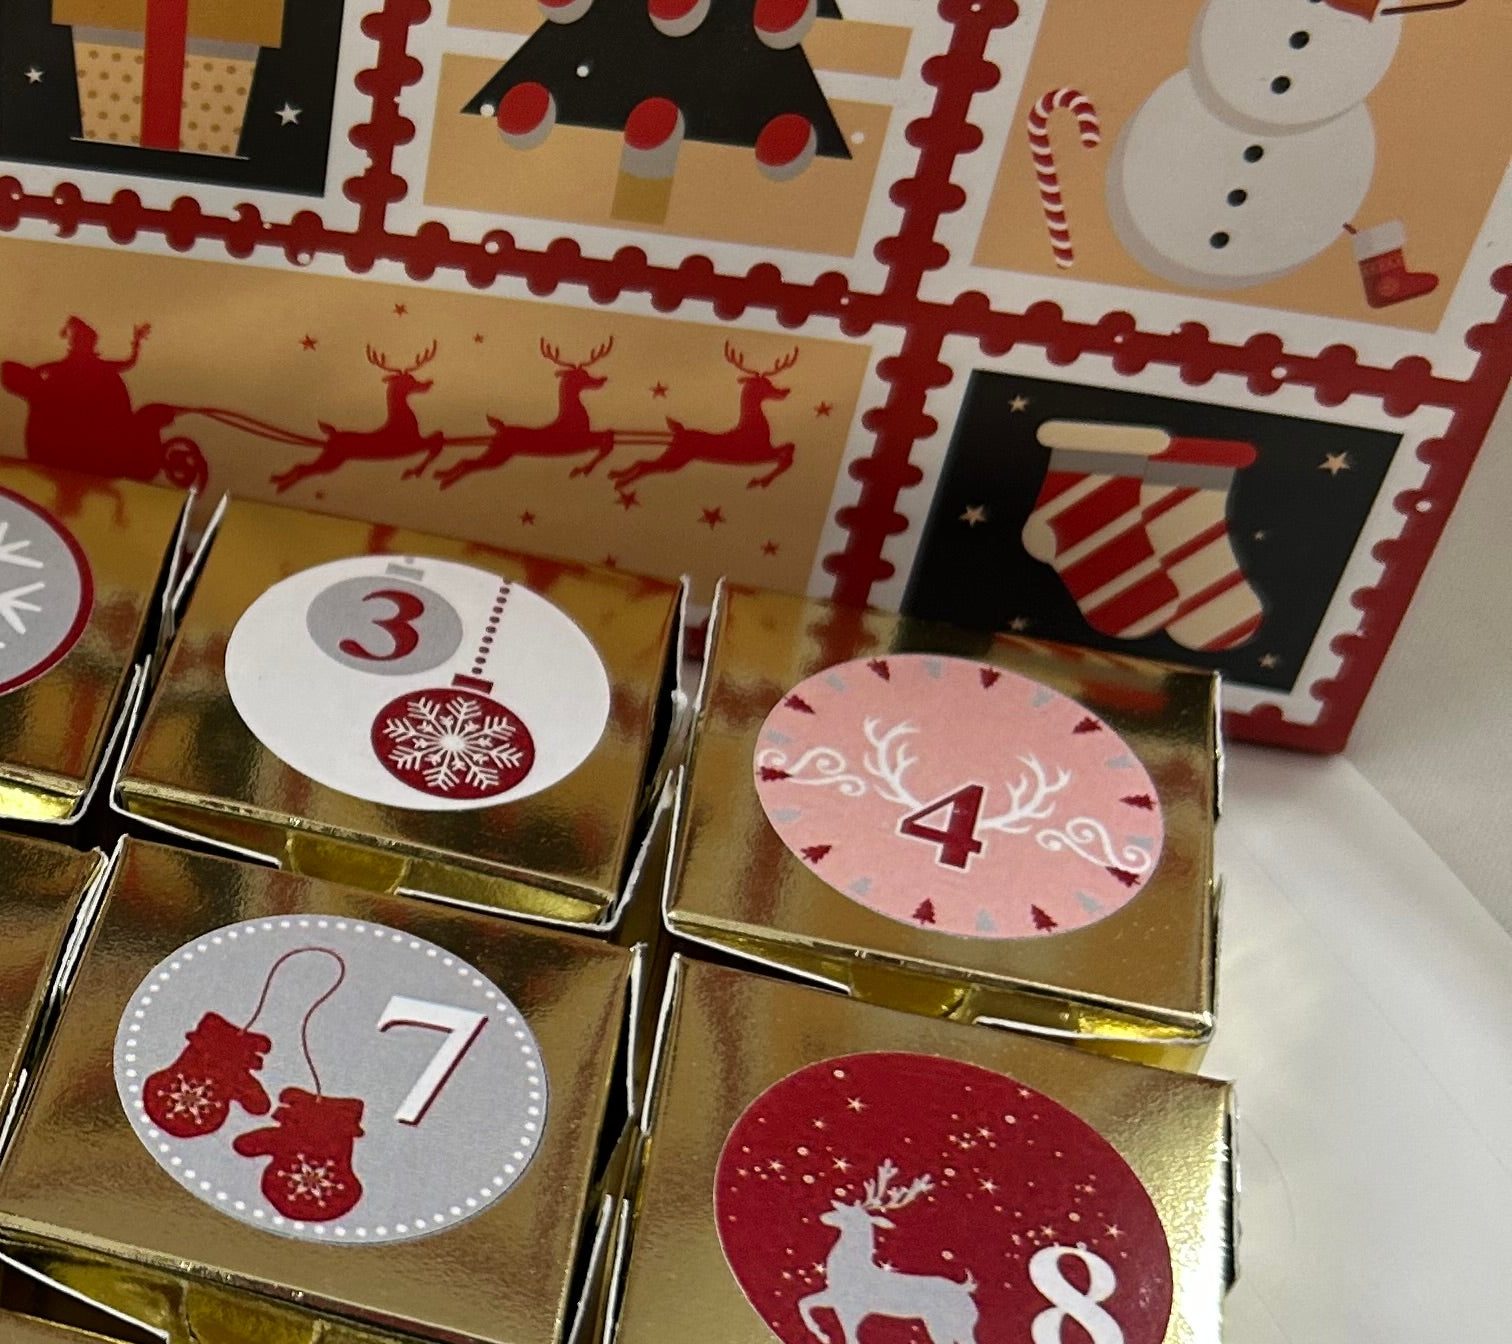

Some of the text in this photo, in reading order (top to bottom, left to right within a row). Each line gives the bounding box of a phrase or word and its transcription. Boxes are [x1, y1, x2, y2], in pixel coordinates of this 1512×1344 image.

[338, 588, 424, 662] 3
[898, 782, 994, 873] 4
[374, 992, 489, 1128] 7
